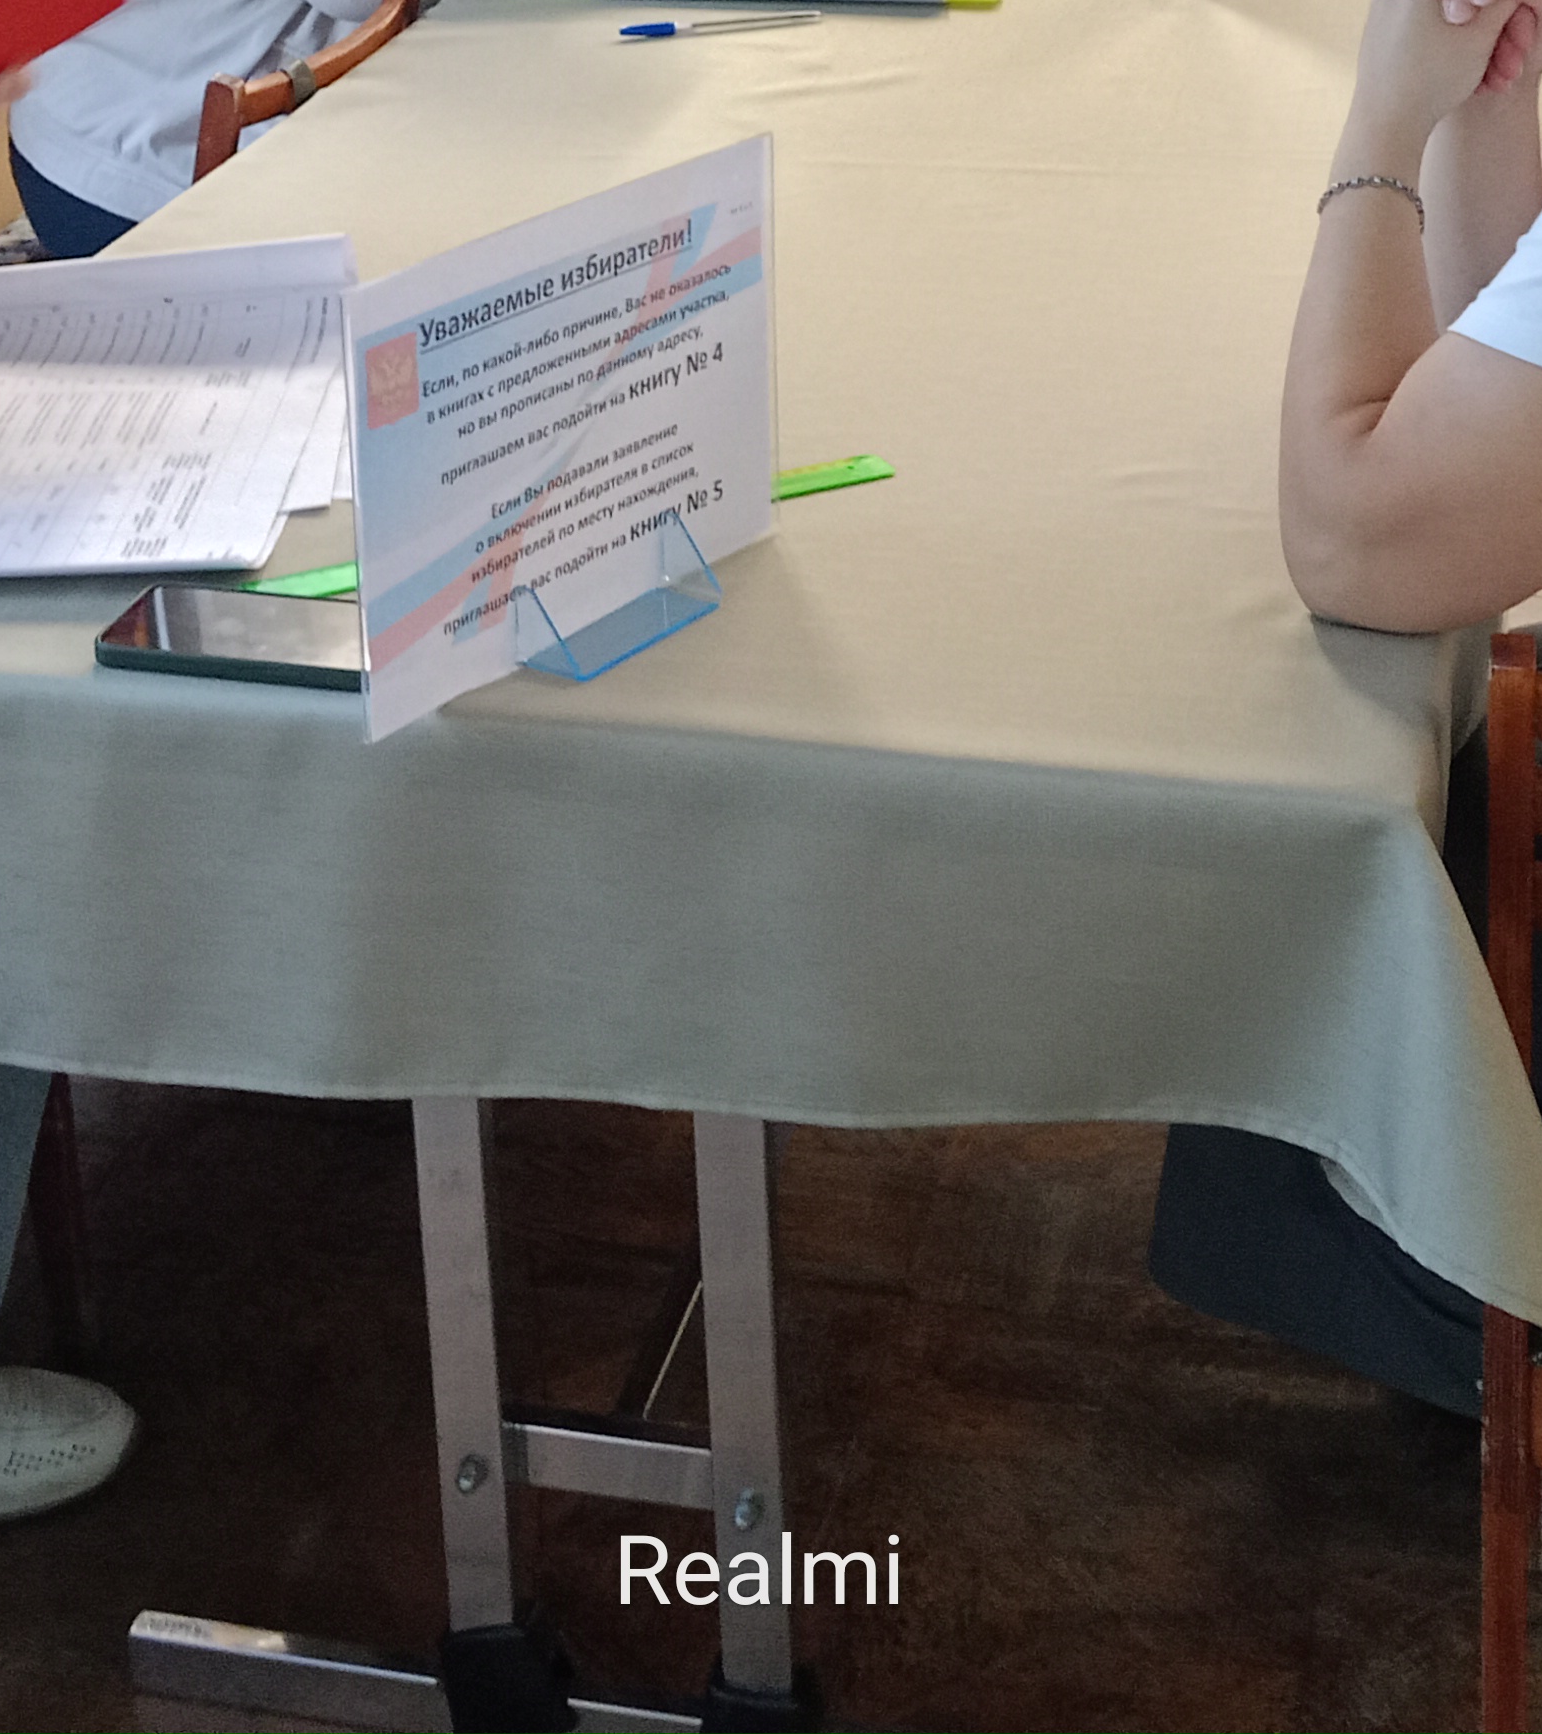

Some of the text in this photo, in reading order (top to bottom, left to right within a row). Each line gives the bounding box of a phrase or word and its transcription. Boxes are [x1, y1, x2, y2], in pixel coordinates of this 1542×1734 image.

[419, 219, 692, 347] Уважаемые избиратели!
[422, 264, 732, 397] Если, по какой-либо причине, Вас не оказалось
[427, 290, 729, 424] в книгах с предложенными адресами участка,
[440, 342, 723, 486] приглашаем вас подойти на книгу № 4
[457, 325, 703, 439] но вы прописаны по данному адресу,
[471, 466, 699, 583] избирателей по месту нахождения,
[475, 442, 694, 554] о включении избирателя в список
[491, 424, 678, 519] Если Вы подавали заявление
[444, 479, 723, 635] приглашаем вас подойти на книгу № 5
